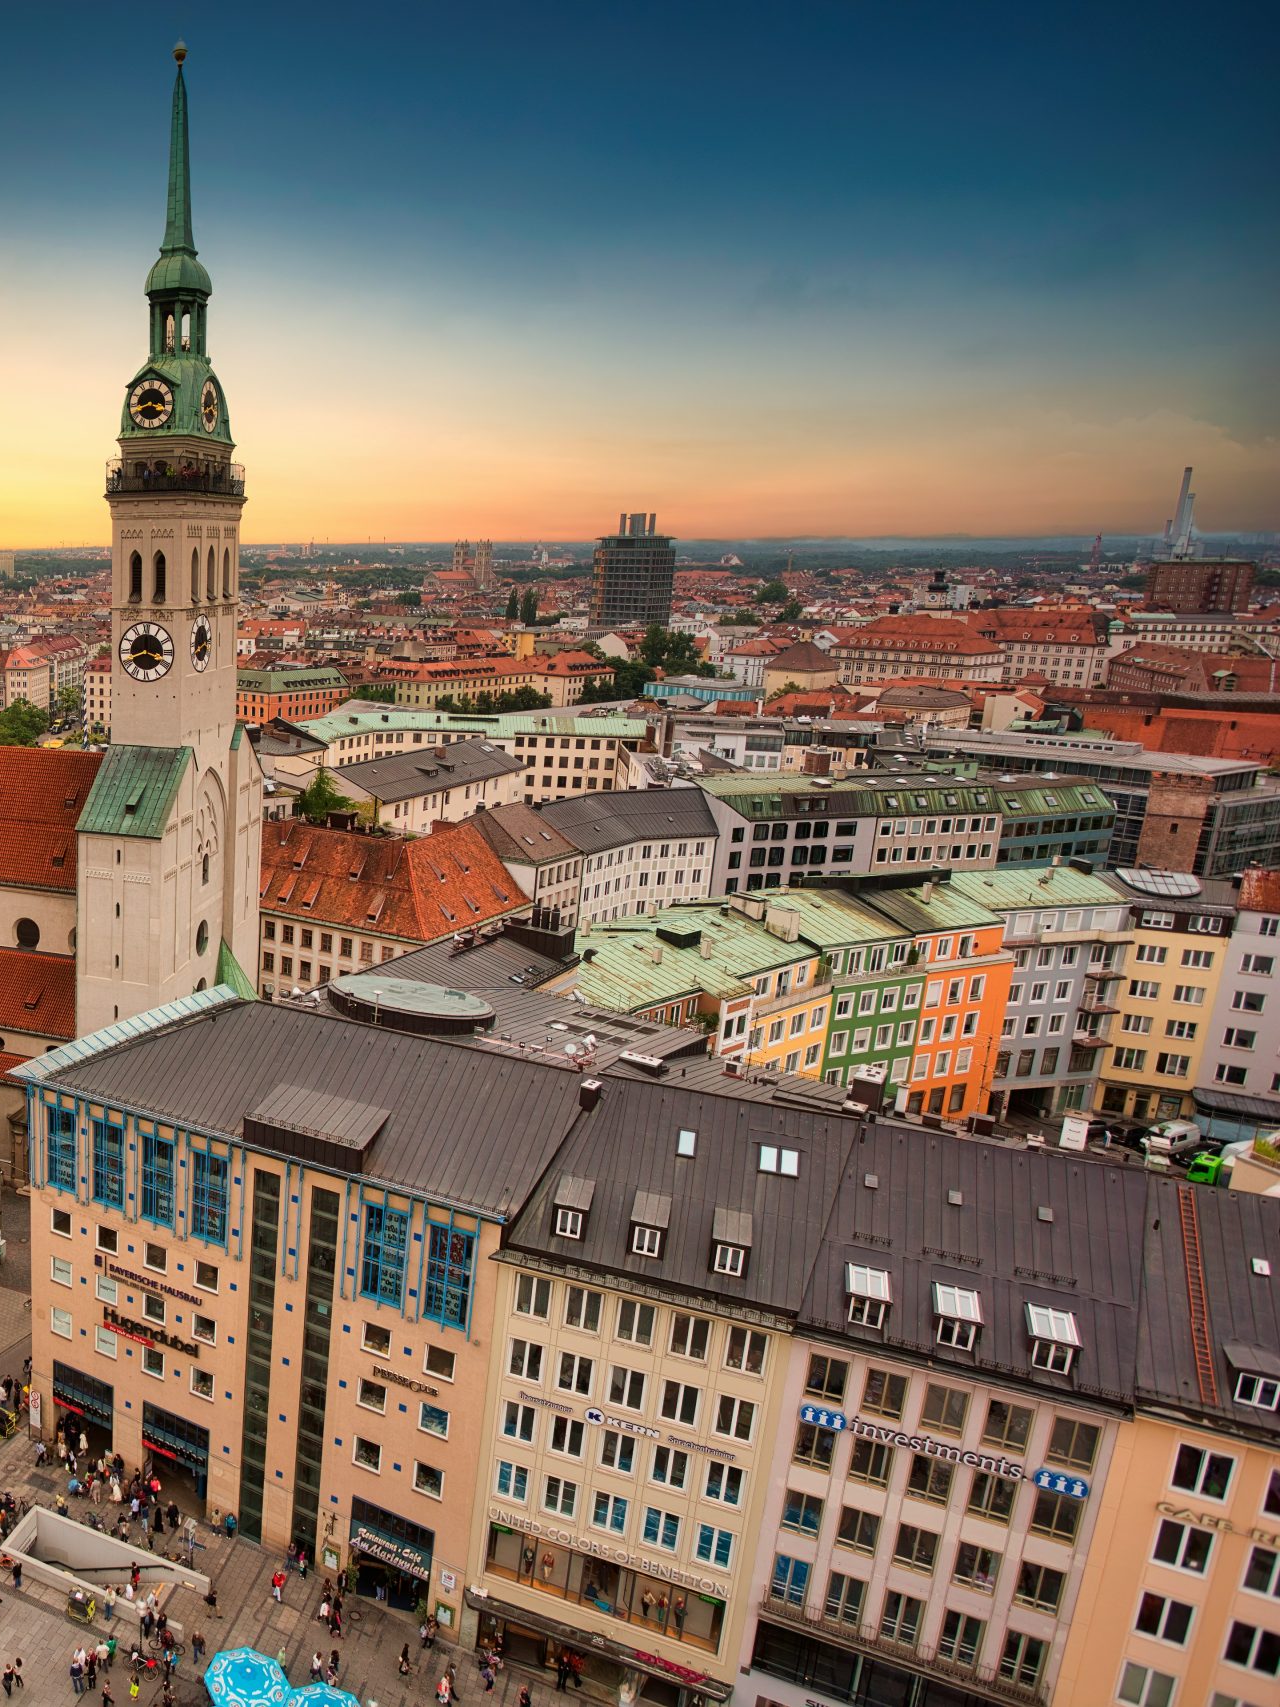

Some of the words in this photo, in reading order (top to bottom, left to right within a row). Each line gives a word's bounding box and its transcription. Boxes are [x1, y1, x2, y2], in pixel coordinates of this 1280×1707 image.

[109, 1263, 159, 1290] BAYERISCHE
[160, 1283, 203, 1306] HAUSBAU
[103, 1306, 199, 1358] Hugendubel
[606, 1416, 660, 1439] KERN
[489, 1506, 542, 1534] UNITED
[546, 1527, 609, 1558] COLORS
[614, 1550, 637, 1565] OF
[350, 1537, 369, 1551] Am
[367, 1544, 429, 1580] Marienplatz
[592, 1635, 605, 1645] 25
